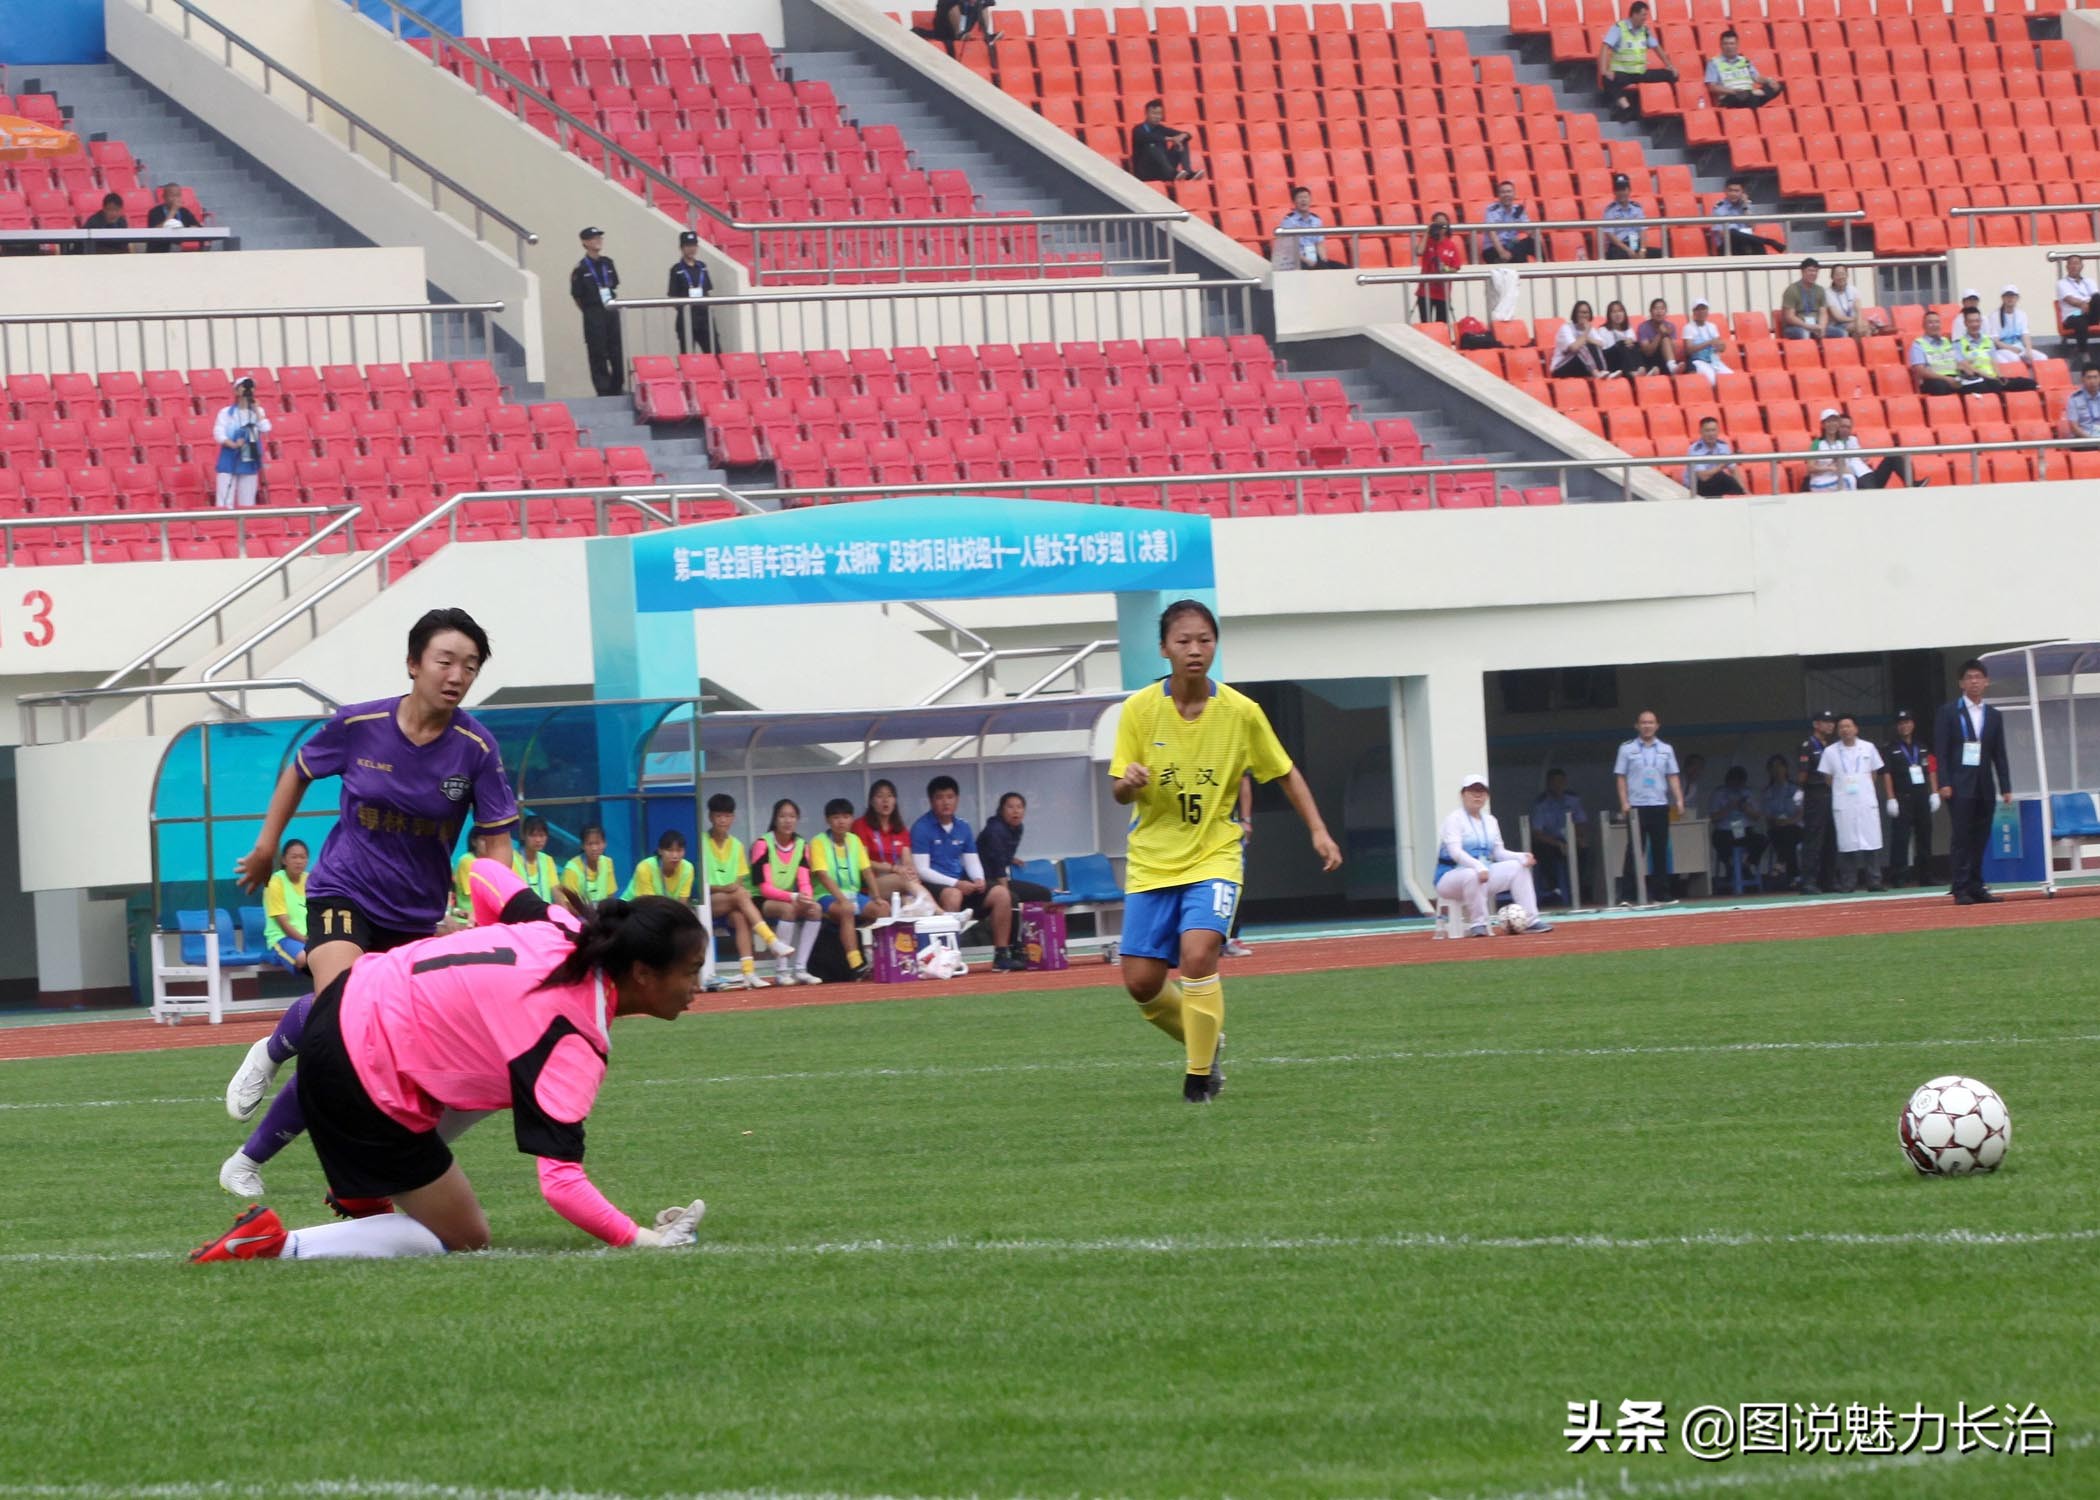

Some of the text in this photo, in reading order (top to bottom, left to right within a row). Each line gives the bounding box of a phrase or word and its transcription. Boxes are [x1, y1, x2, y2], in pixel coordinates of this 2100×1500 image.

[0, 590, 55, 648] 3
[1159, 763, 1220, 789] 武汉
[1178, 793, 1203, 824] 15
[1211, 882, 1236, 916] 15
[320, 908, 353, 935] 11
[412, 947, 517, 975] 1
